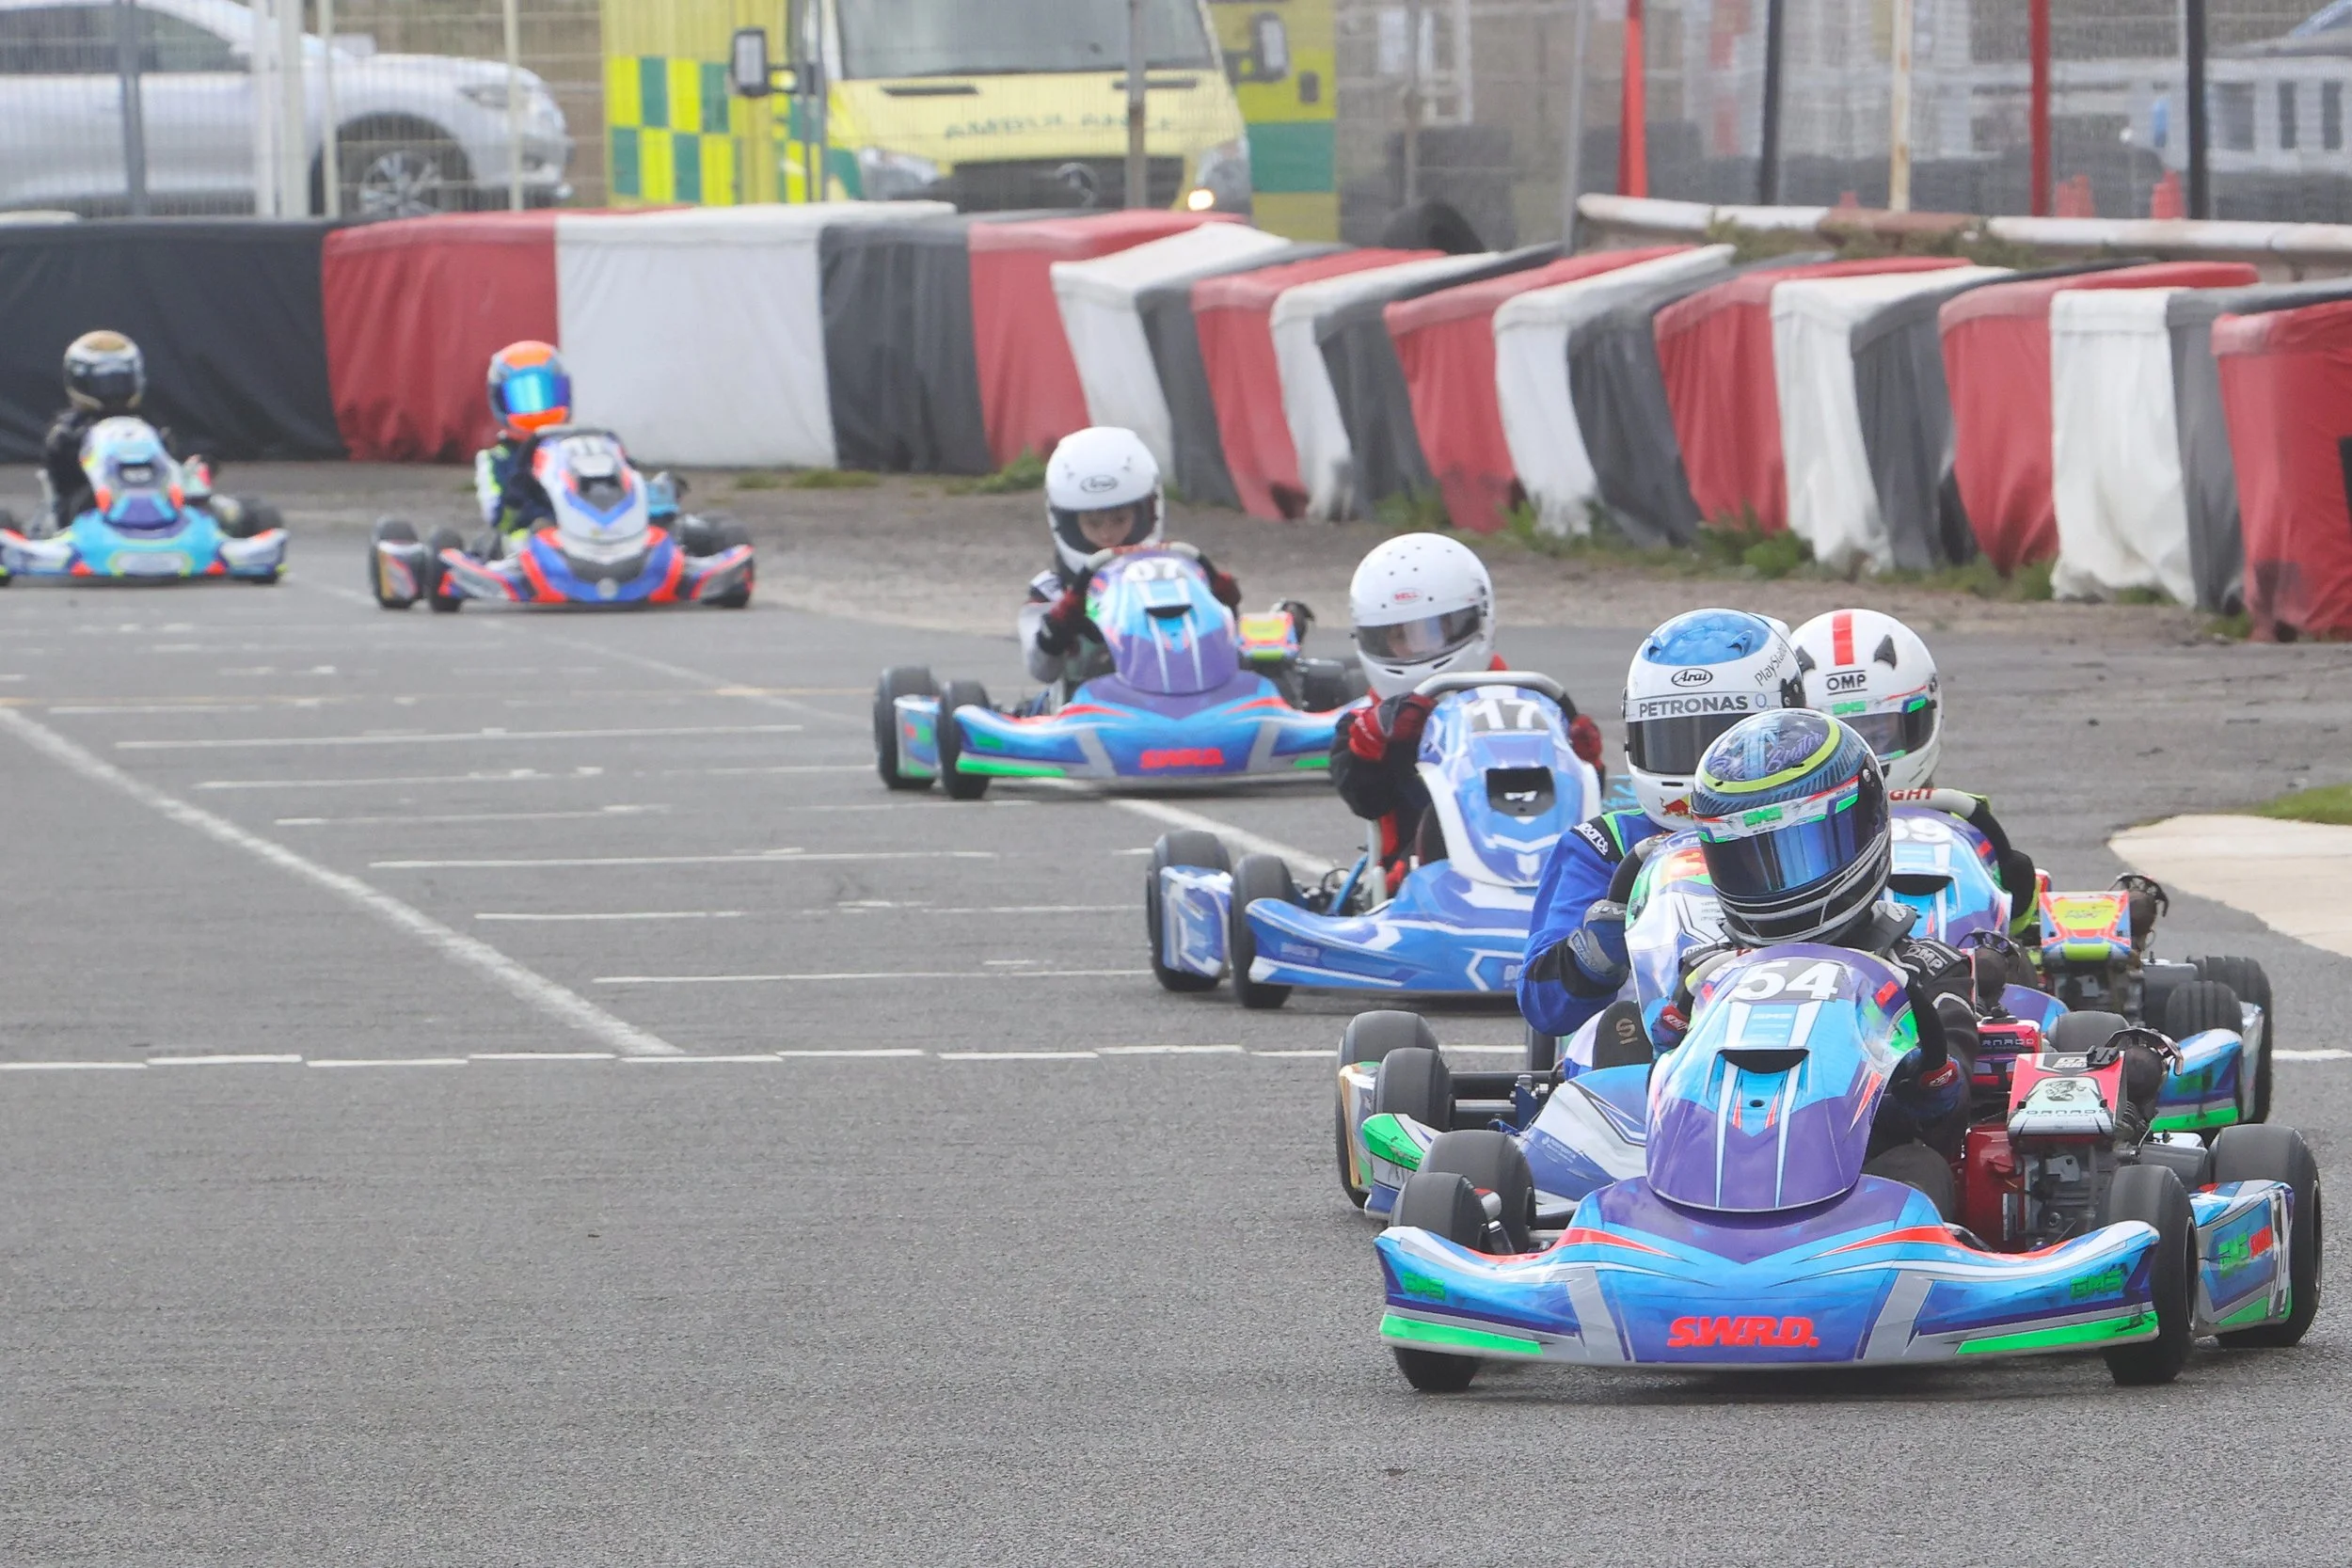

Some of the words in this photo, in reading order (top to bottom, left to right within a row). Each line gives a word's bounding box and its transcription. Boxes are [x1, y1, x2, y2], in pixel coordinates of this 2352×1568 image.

[1676, 670, 1709, 683] Arai
[1826, 673, 1867, 690] OMP
[1471, 699, 1540, 730] 17
[1639, 695, 1749, 719] PETRONAS
[1574, 820, 1610, 857] sparco
[1906, 944, 1945, 972] OMP
[1733, 960, 1841, 1001] 54
